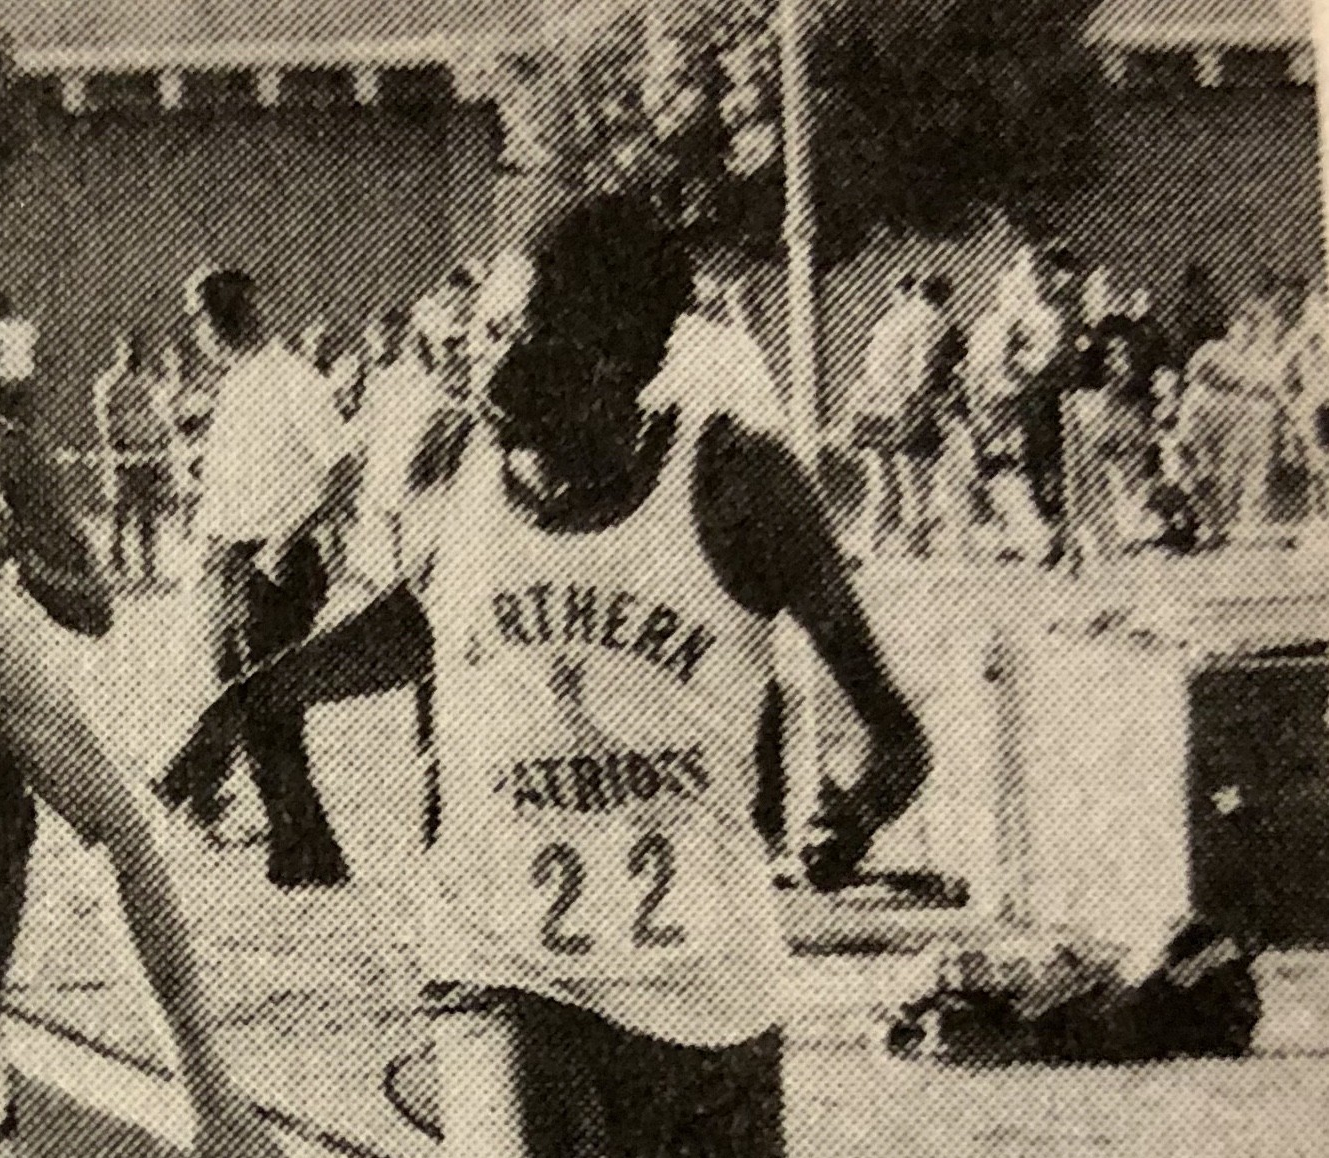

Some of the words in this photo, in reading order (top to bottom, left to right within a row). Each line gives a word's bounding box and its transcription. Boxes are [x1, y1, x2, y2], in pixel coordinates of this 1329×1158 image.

[468, 580, 717, 684] RTHERN
[493, 742, 713, 814] ATRIOTS
[529, 829, 686, 957] 22
